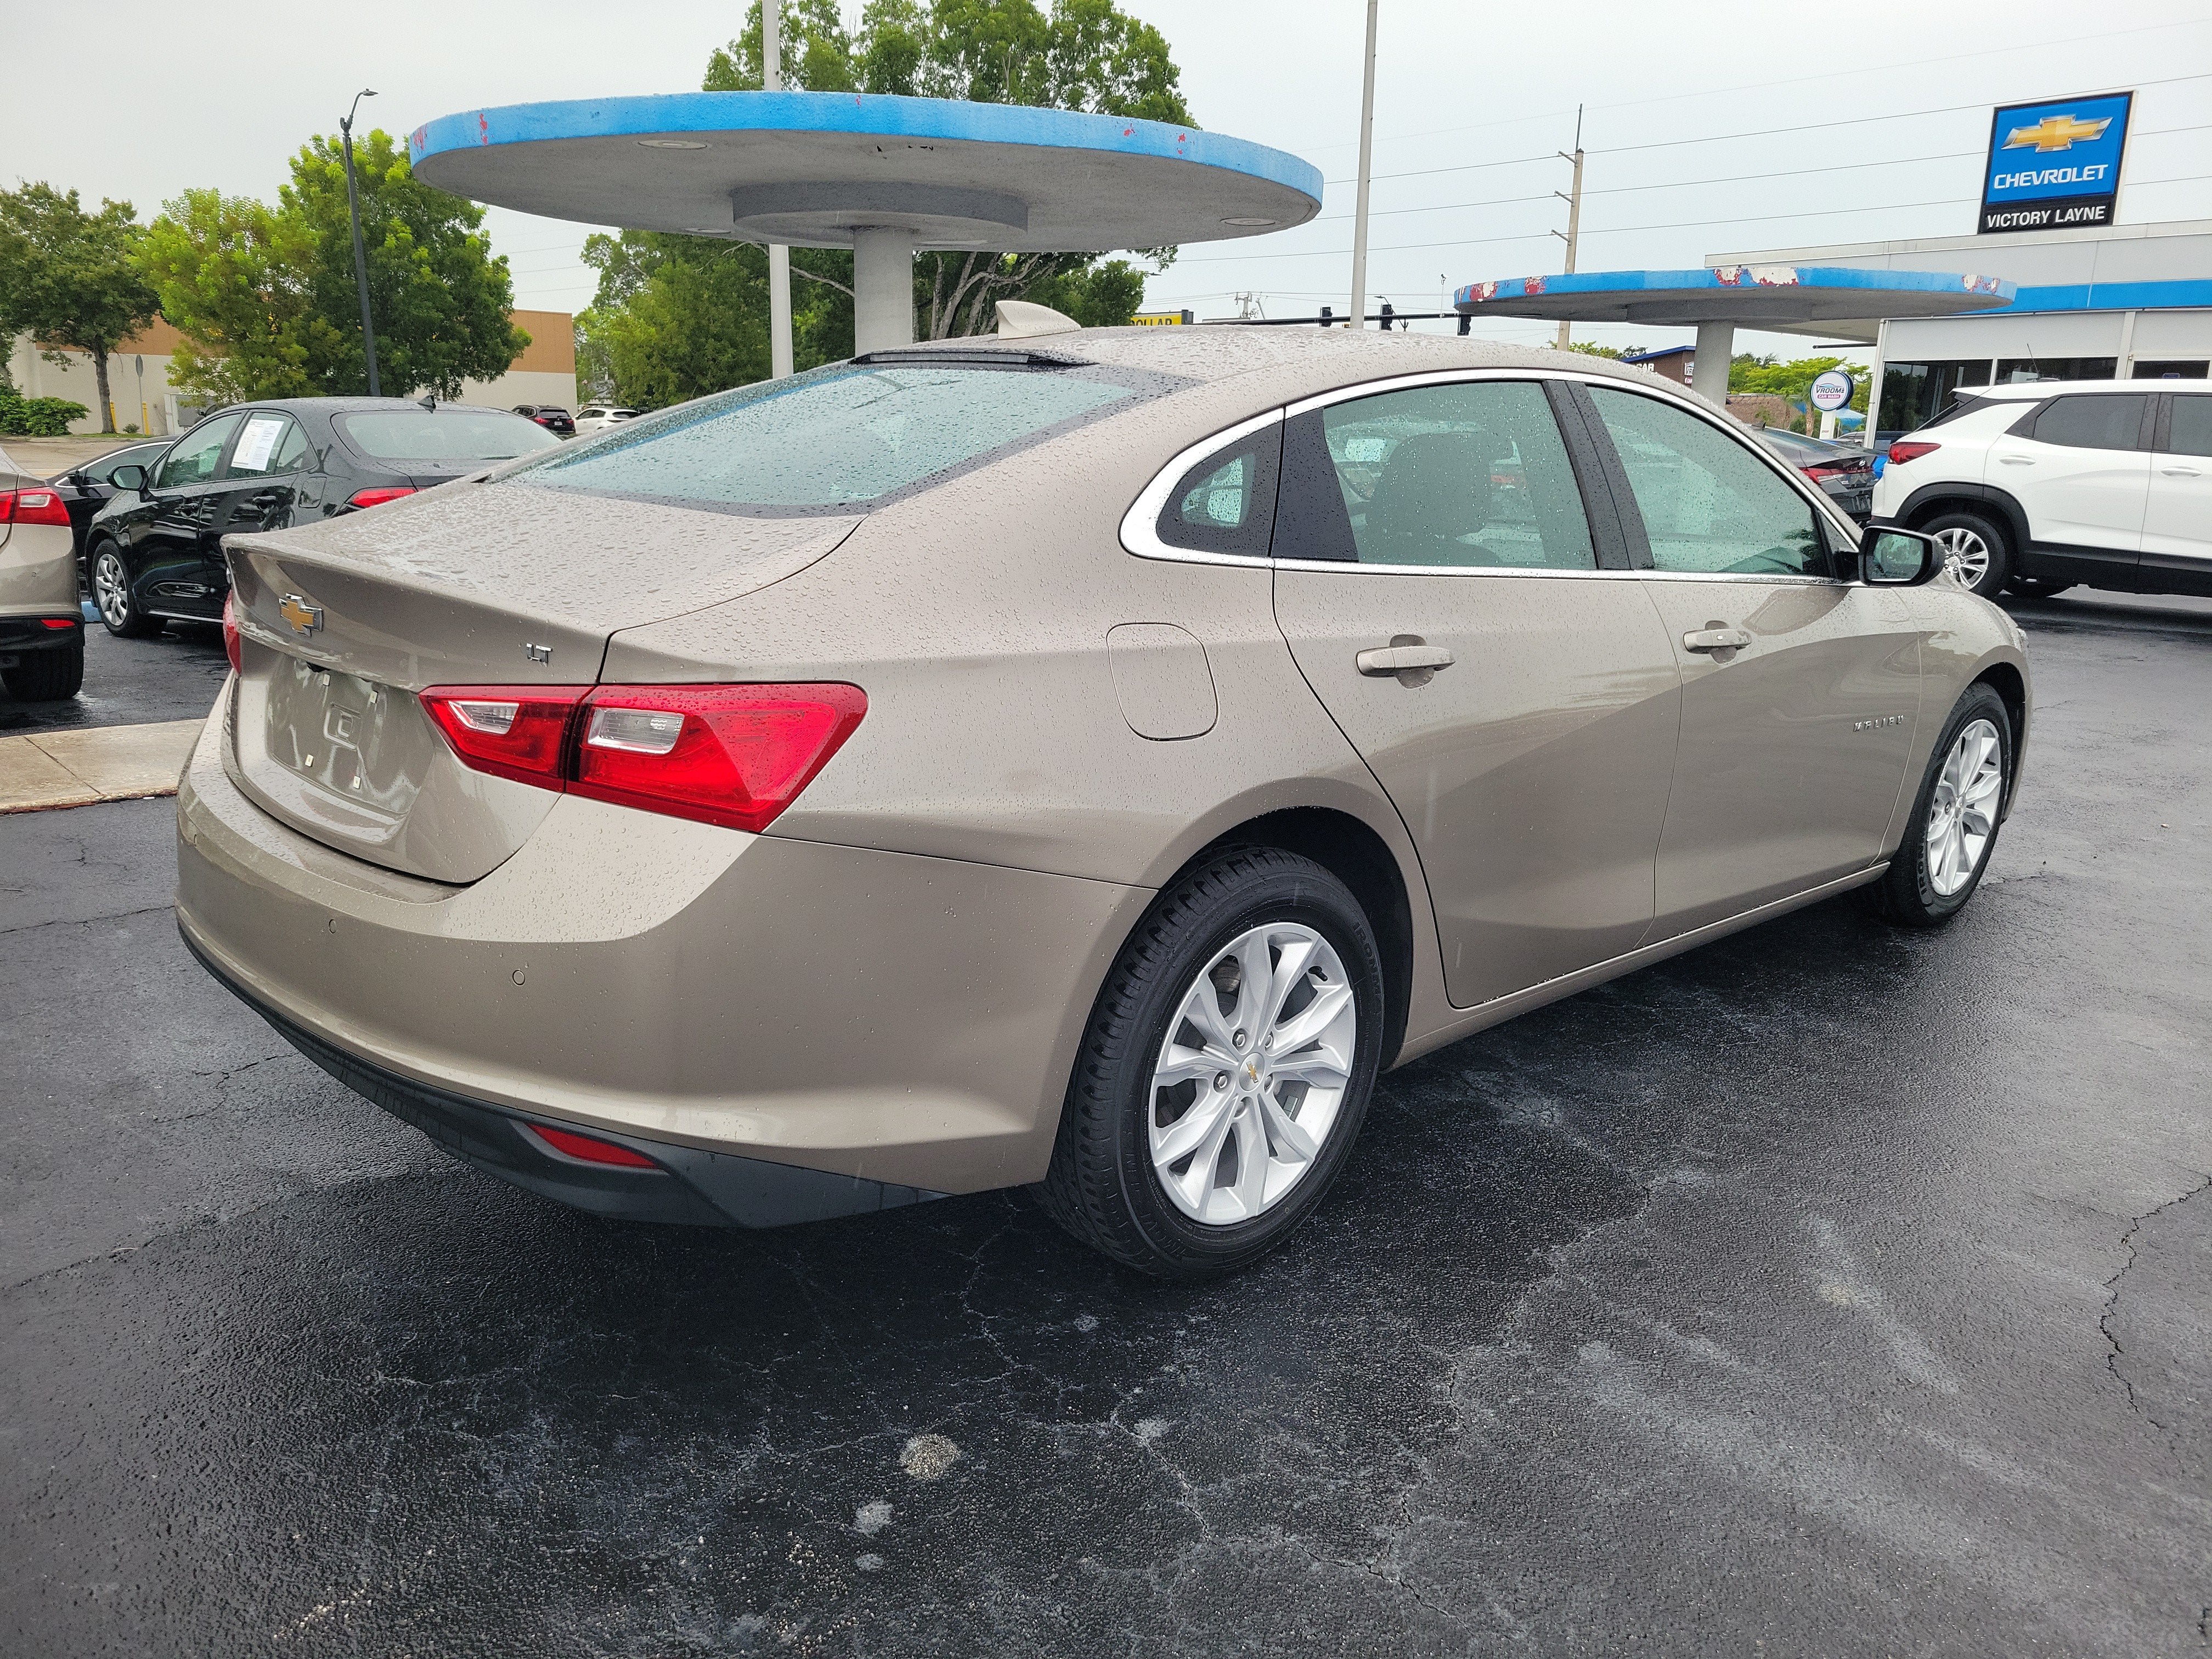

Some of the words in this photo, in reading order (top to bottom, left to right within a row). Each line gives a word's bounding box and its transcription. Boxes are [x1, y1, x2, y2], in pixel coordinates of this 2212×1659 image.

[1994, 165, 2108, 189] CHEVROLET
[1987, 210, 2051, 228] VICTORY
[2055, 206, 2106, 223] LAYNE
[1816, 385, 1842, 393] VROOM
[527, 643, 552, 665] LT
